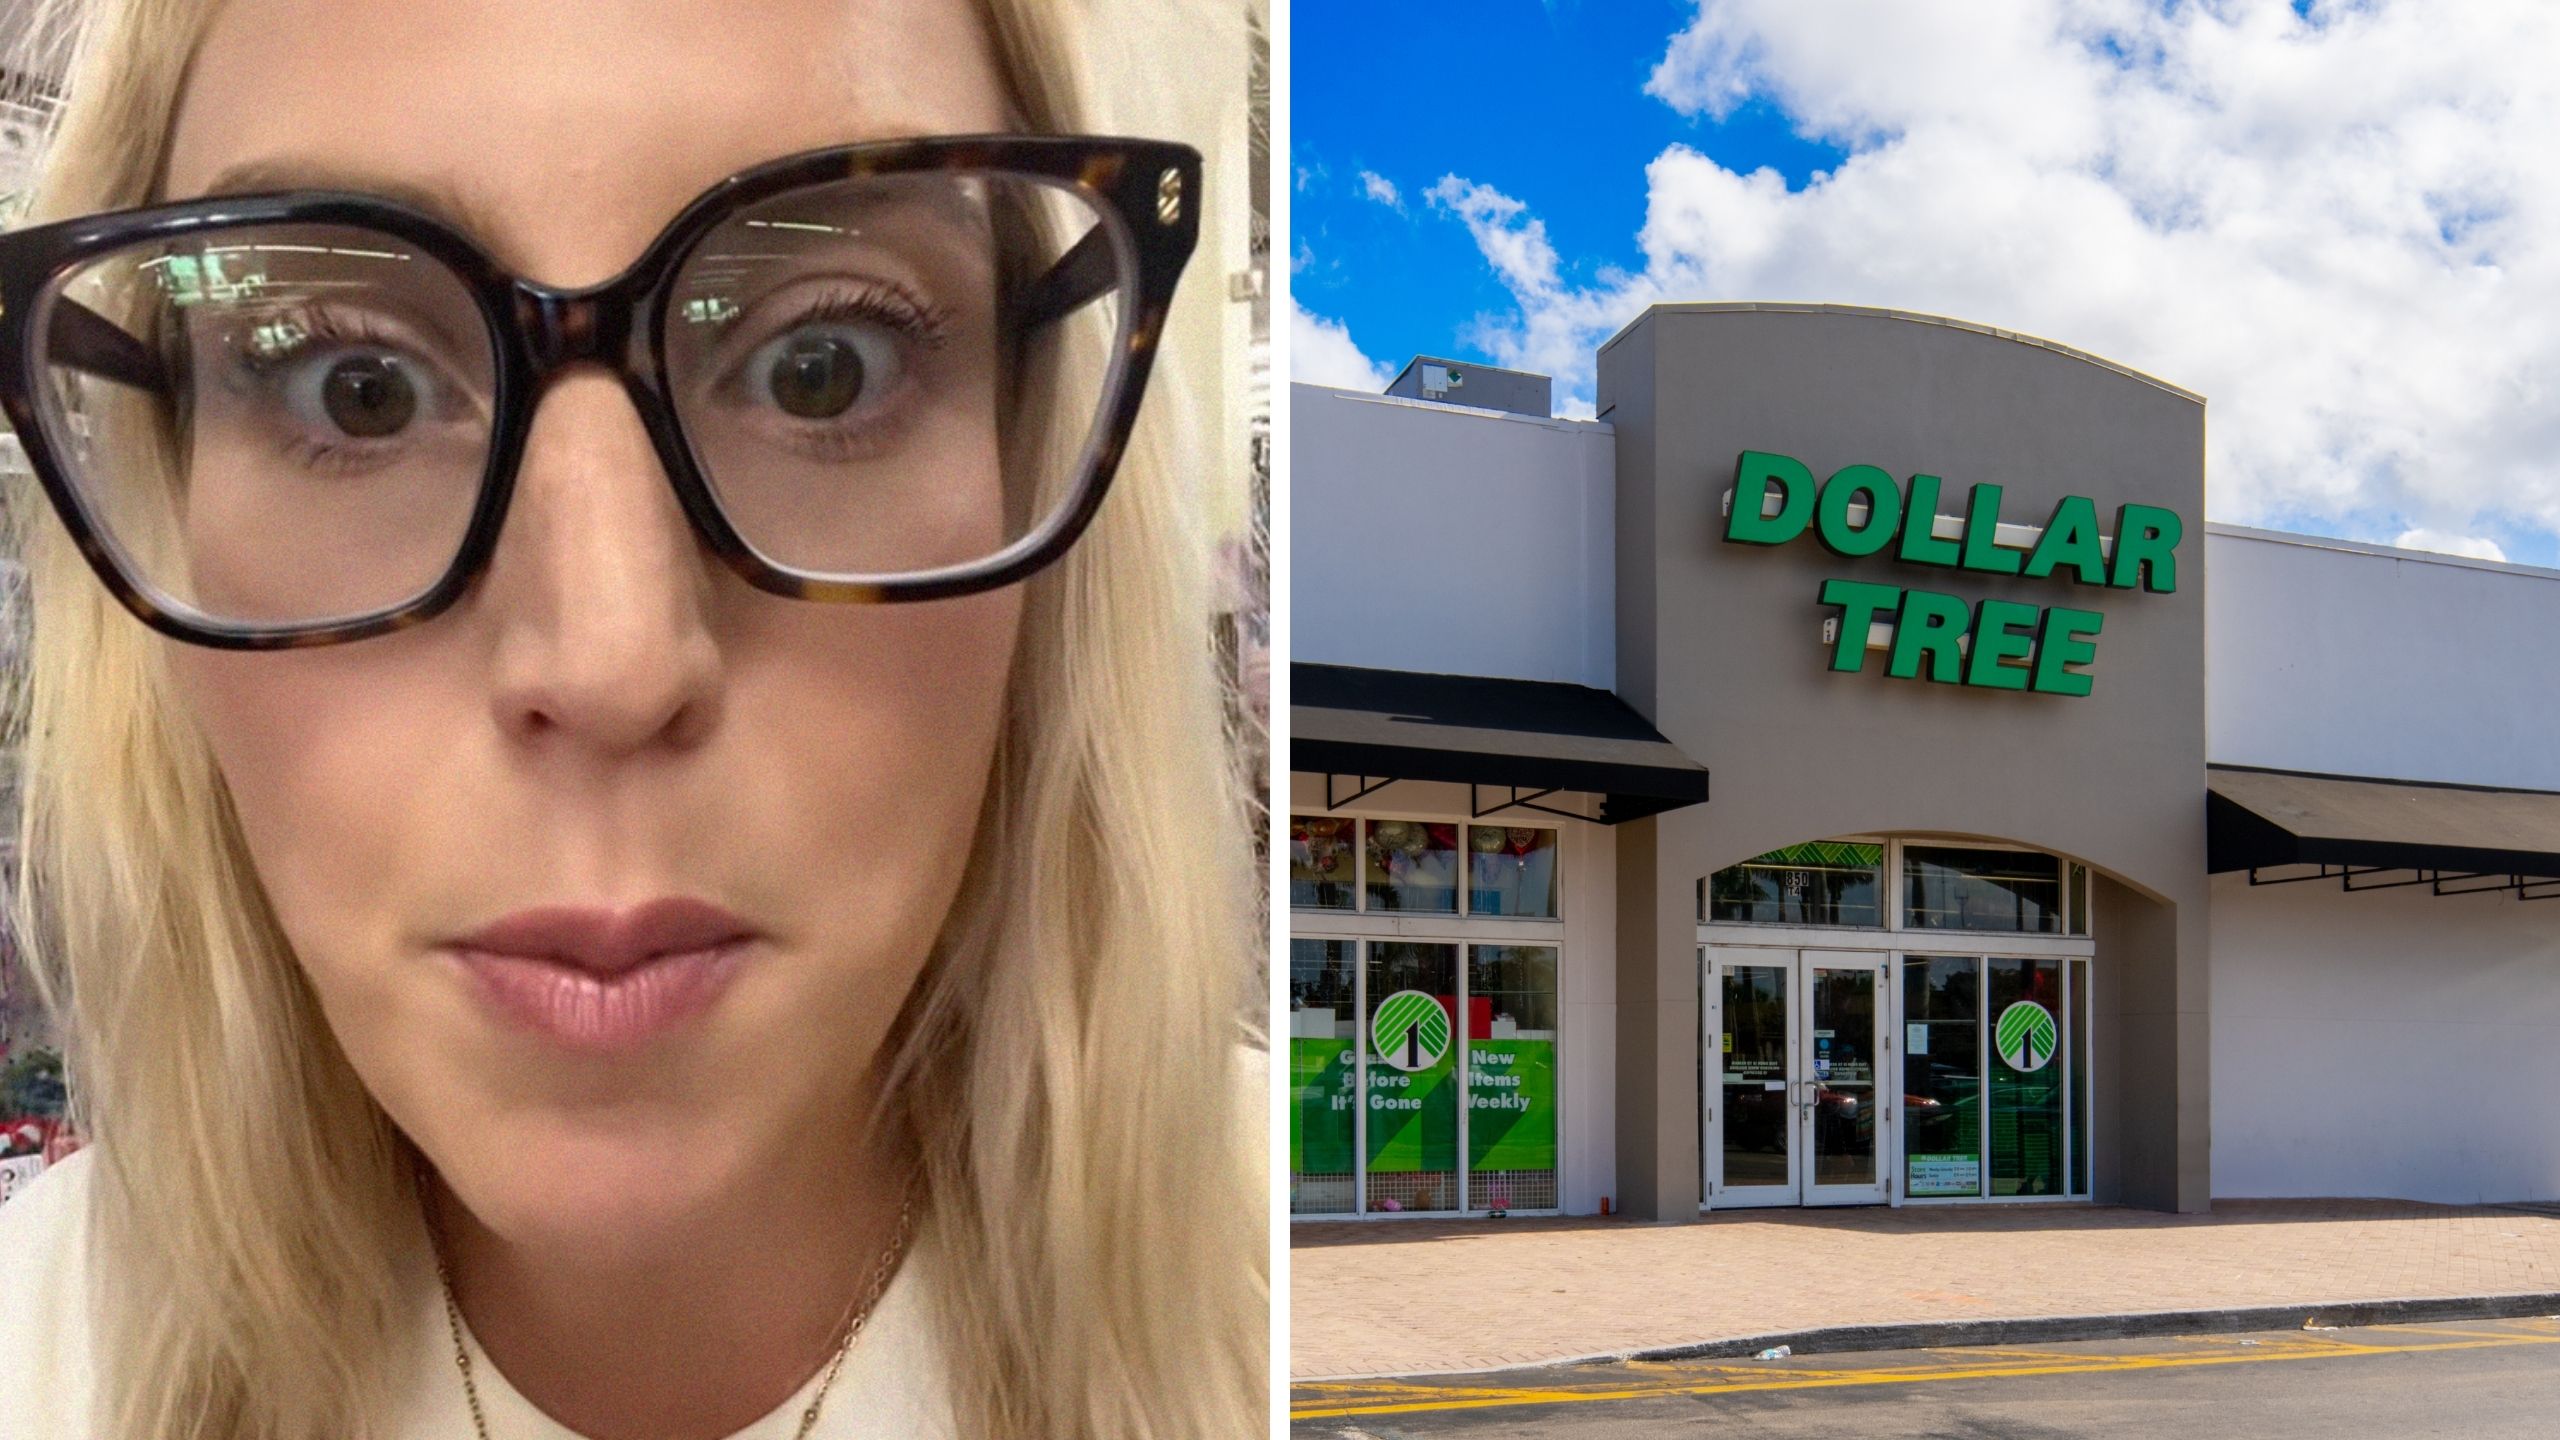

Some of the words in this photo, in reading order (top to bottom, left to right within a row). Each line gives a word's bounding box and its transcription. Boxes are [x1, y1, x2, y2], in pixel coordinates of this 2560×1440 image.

[1723, 450, 2182, 594] DOLLAR
[1817, 579, 2104, 696] TREE
[1787, 872, 1808, 886] 850
[1471, 1050, 1516, 1065] New
[1343, 1071, 1411, 1088] Bfore
[1468, 1072, 1521, 1087] Items
[1370, 1094, 1422, 1110] Gone
